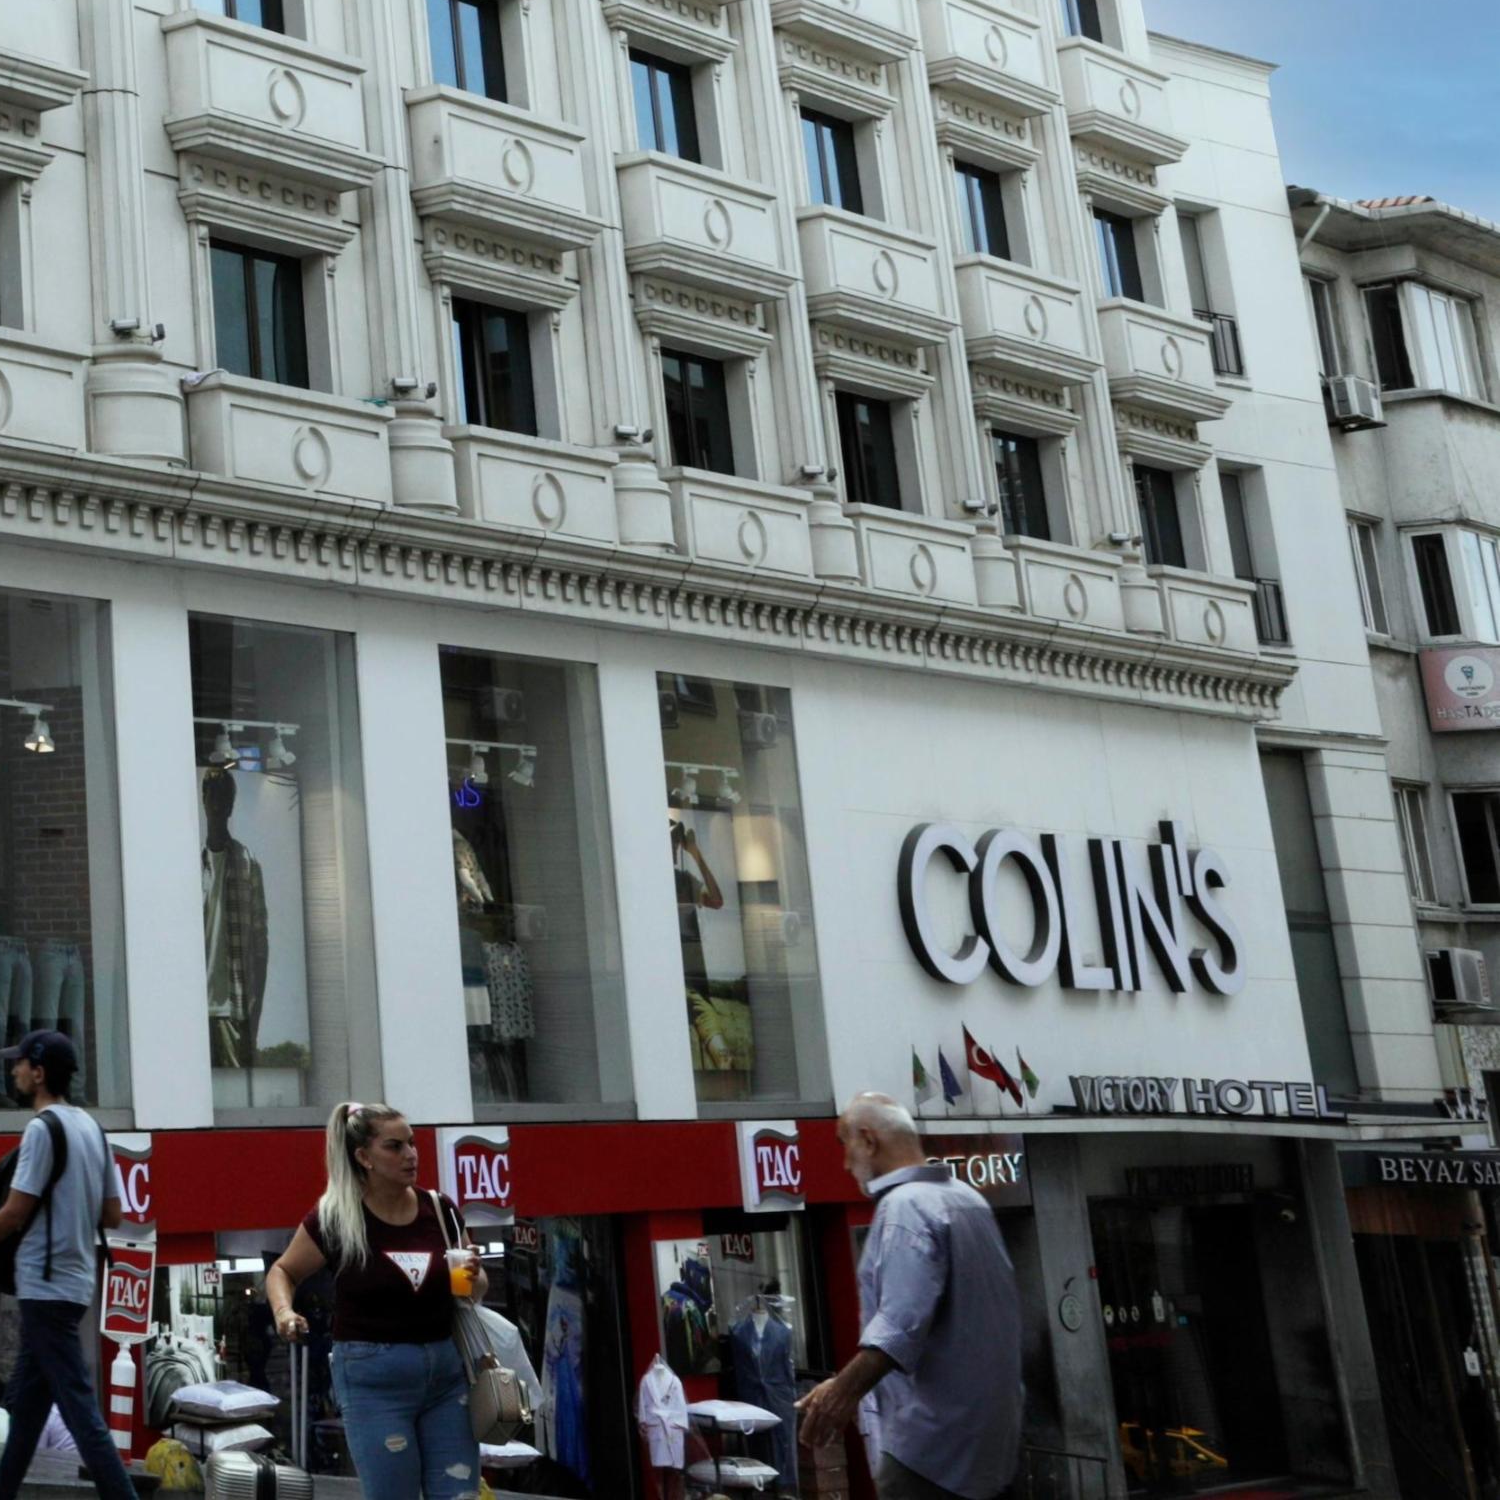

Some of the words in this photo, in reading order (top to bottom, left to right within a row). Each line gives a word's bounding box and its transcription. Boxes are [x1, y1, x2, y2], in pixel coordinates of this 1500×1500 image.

[898, 820, 1247, 996] COLIN'S
[1069, 1076, 1178, 1113] VICTORY
[1183, 1078, 1346, 1119] HOTEL
[1379, 1157, 1468, 1184] BEYAZ
